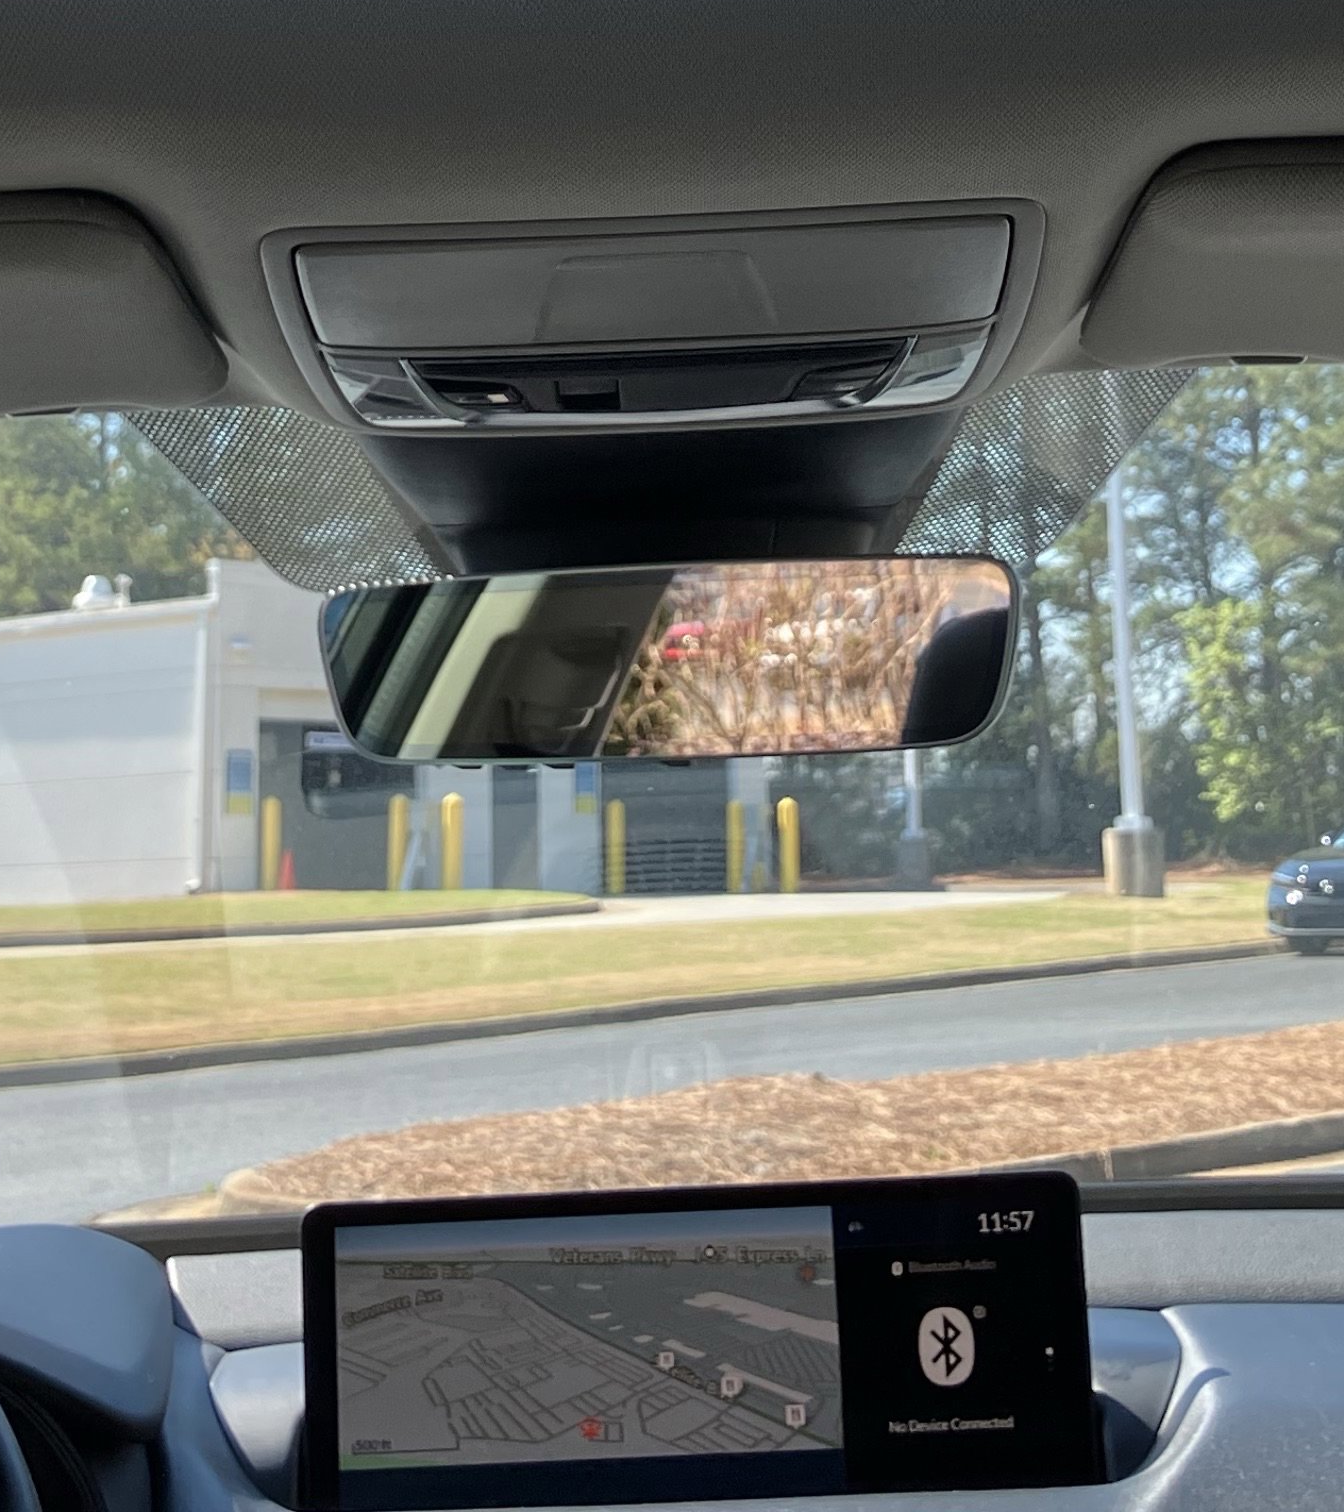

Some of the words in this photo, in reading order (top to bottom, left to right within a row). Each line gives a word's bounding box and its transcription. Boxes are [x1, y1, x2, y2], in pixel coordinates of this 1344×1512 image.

[977, 1210, 1035, 1233] 11:57
[550, 1248, 623, 1264] Veterans
[735, 1246, 801, 1266] Express
[888, 1420, 908, 1433] No
[950, 1416, 1015, 1431] Connected
